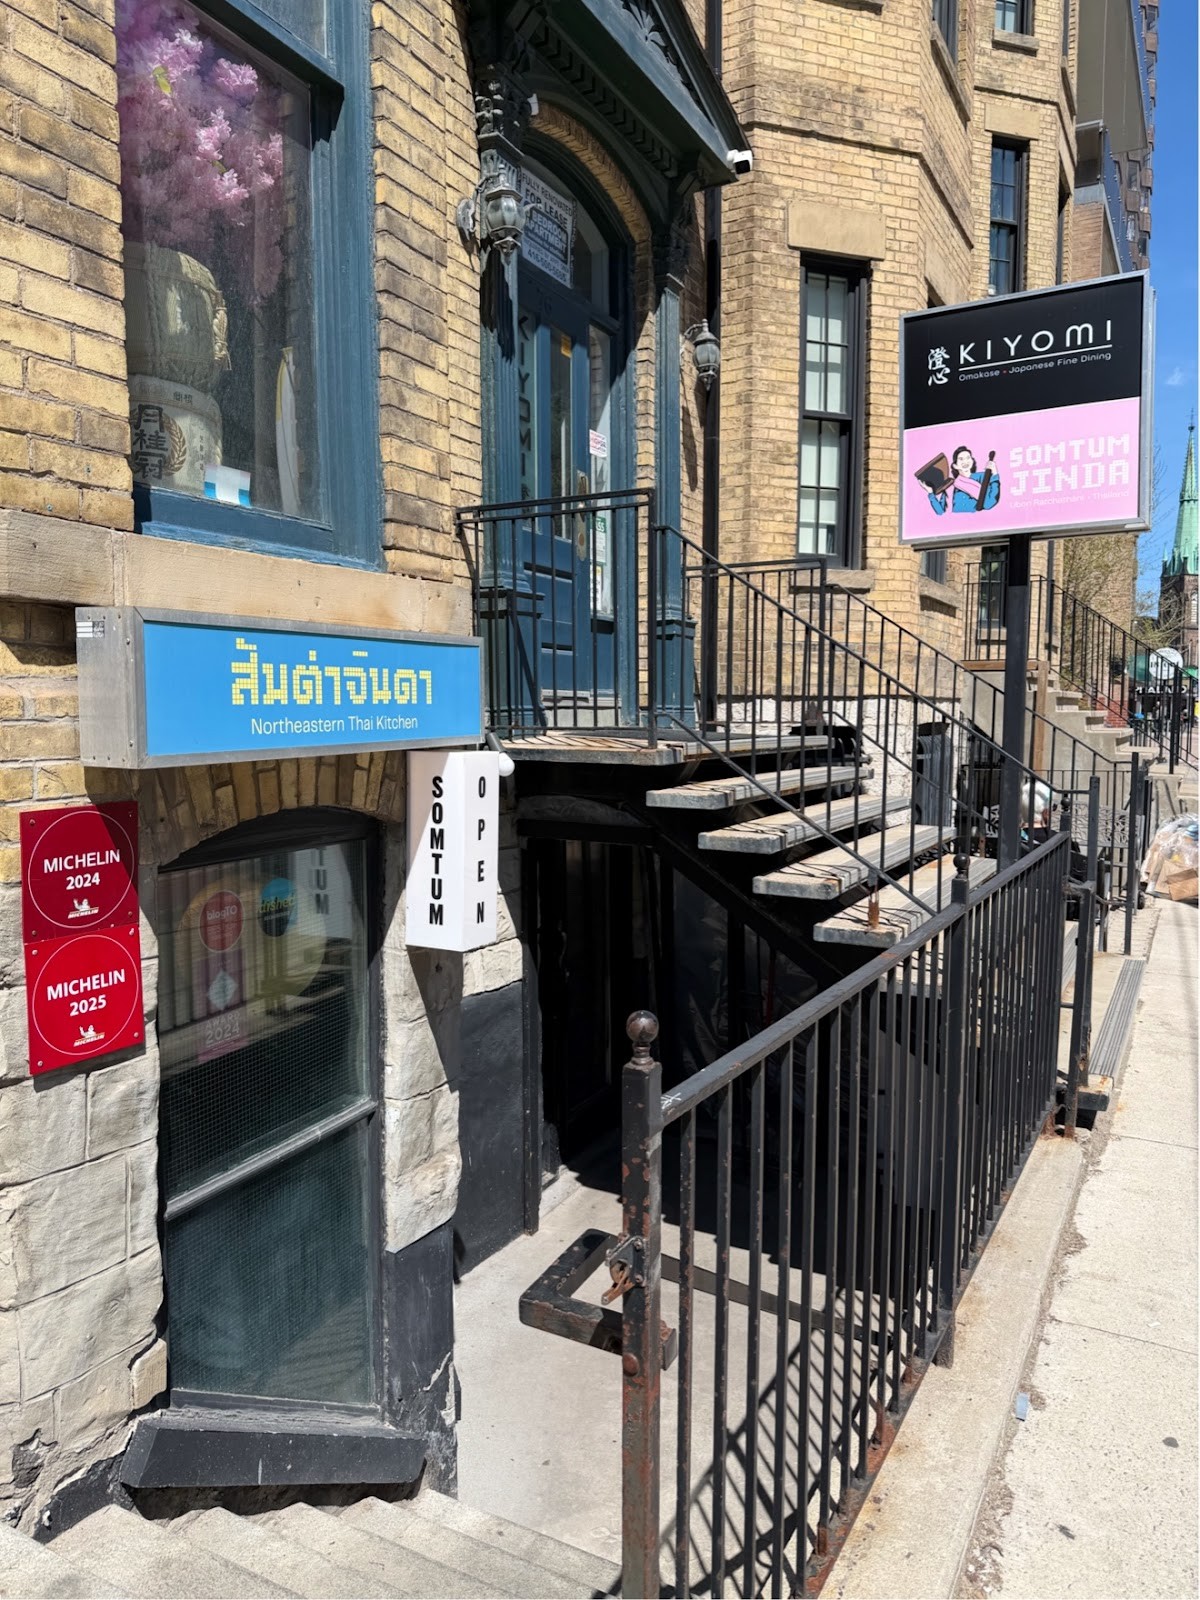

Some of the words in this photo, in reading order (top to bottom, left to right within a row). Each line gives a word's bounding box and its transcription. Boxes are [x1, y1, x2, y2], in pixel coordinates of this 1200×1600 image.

[521, 173, 540, 190] FULLY
[541, 185, 572, 216] RENOVATED
[525, 188, 542, 209] FOR
[544, 199, 568, 230] LEASE
[959, 320, 1111, 364] KIYOMI
[959, 370, 1000, 381] Omakase
[1008, 360, 1054, 374] Japanese
[1057, 357, 1078, 366] Fine
[1080, 352, 1112, 363] Dining
[132, 403, 168, 480] 月桂冠
[1009, 434, 1129, 467] SOMTUM
[1010, 459, 1129, 496] JINDA
[251, 717, 345, 734] Northeastern
[348, 715, 373, 731] Thai
[377, 715, 418, 730] Kitchen
[44, 849, 120, 873] MICHELIN
[429, 776, 444, 925] SOMTUM
[477, 776, 486, 924] OPEN
[66, 872, 100, 890] 2024
[207, 905, 238, 920] blogTO
[47, 969, 125, 1000] MICHELIN
[69, 994, 107, 1016] 2025
[205, 1011, 240, 1030] AWARD
[205, 1022, 240, 1044] 2024
